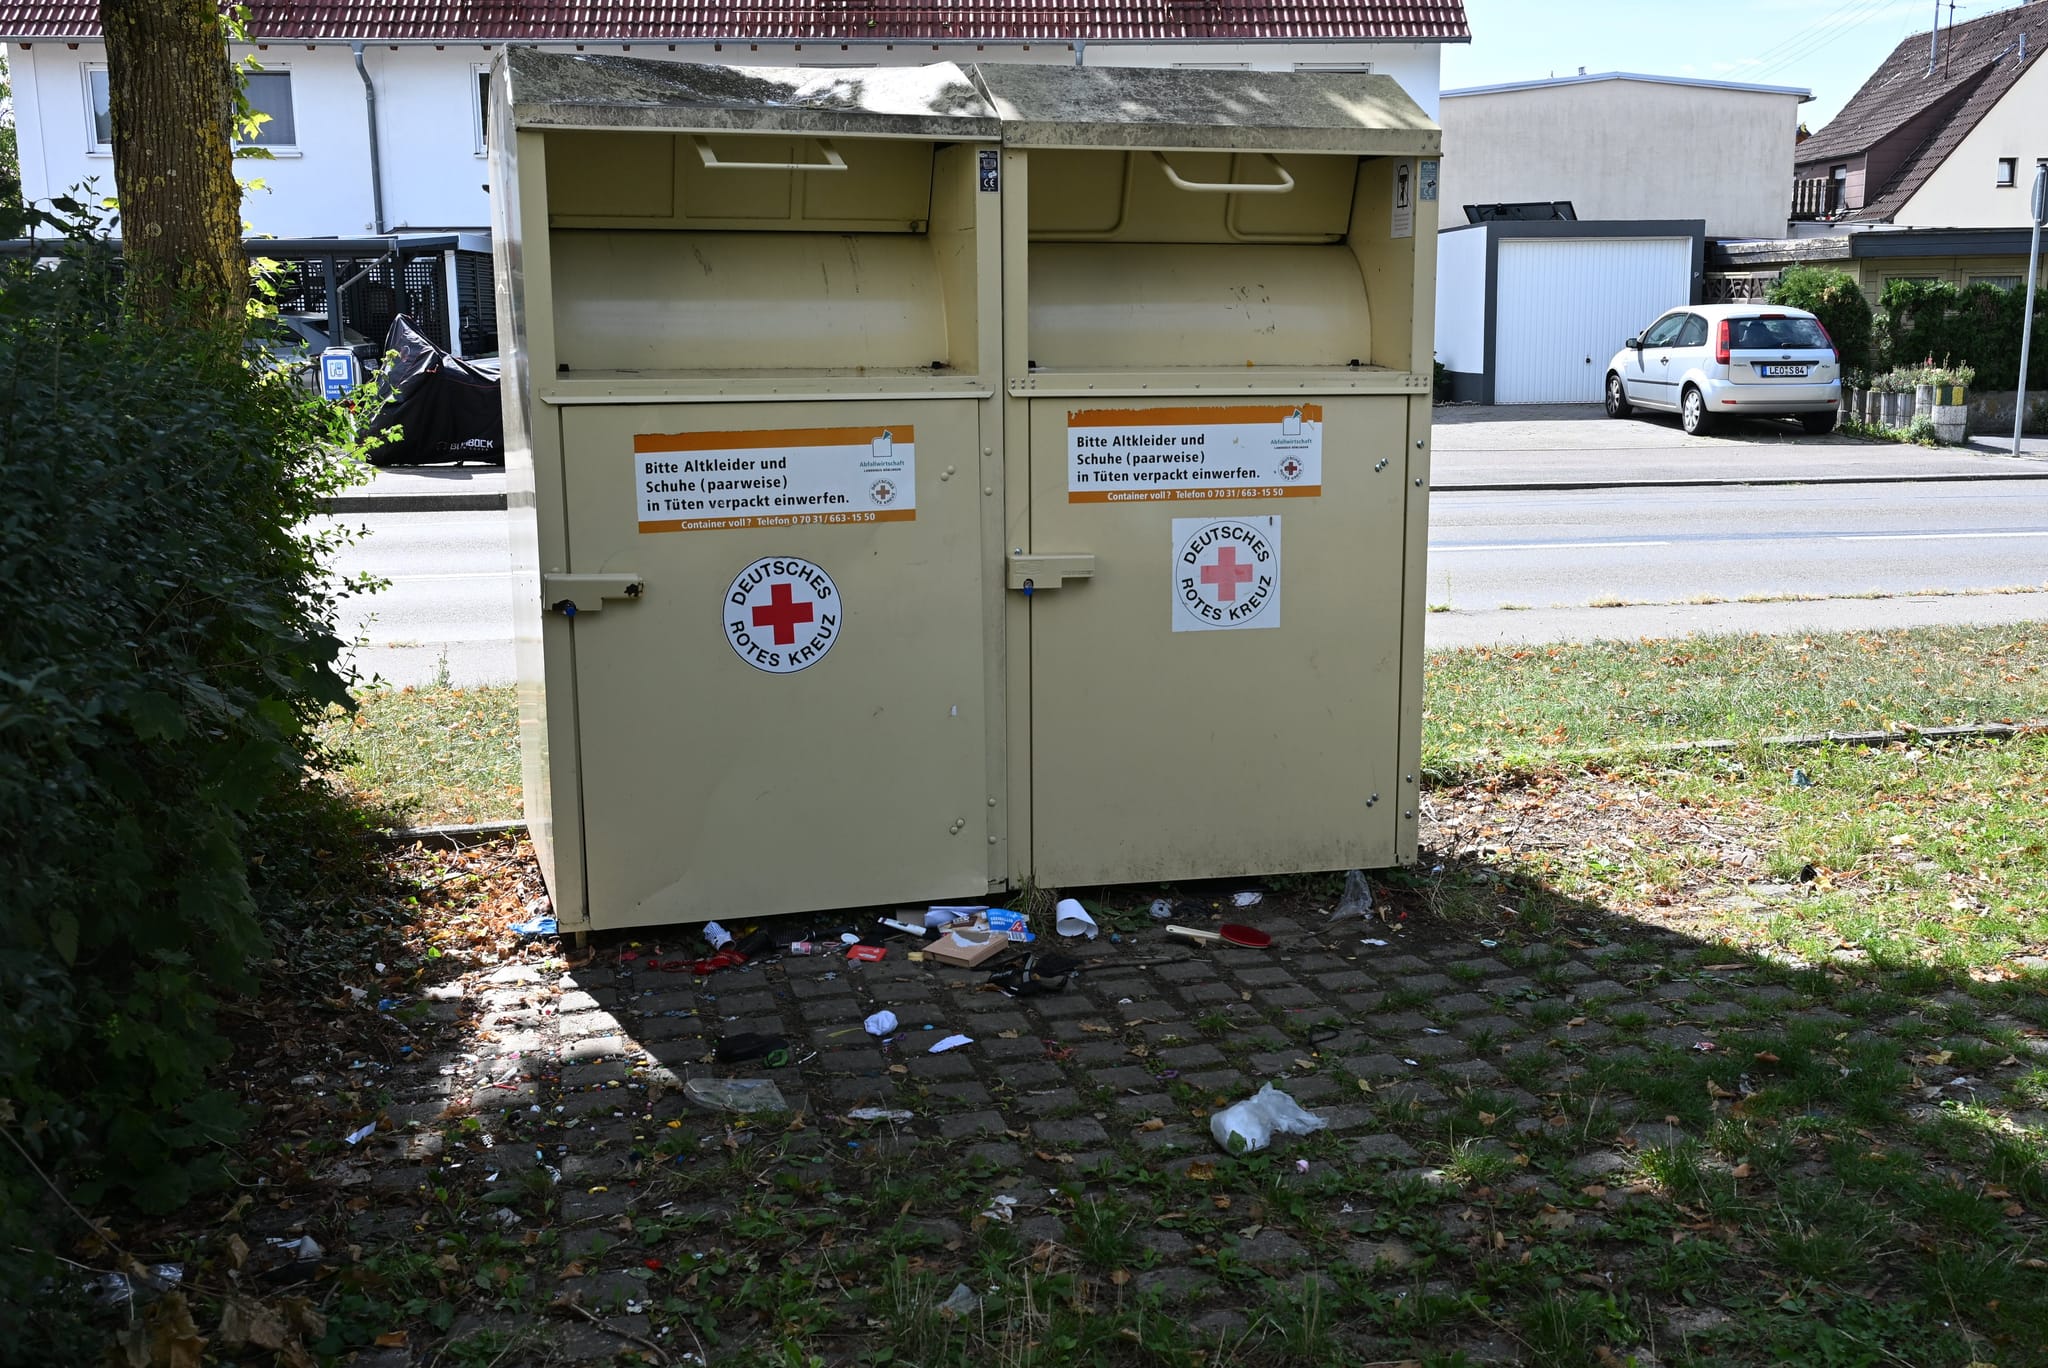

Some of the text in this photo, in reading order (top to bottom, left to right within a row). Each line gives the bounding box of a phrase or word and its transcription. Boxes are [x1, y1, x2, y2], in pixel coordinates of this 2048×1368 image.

[1769, 366, 1785, 375] LEO
[1077, 434, 1204, 448] Bitte Altkleider und
[646, 456, 786, 474] Bitte Altkleider und
[1077, 450, 1204, 466] Schuhe (paarweise)
[646, 475, 788, 494] Schuhe (paarweise)
[1077, 467, 1260, 484] in Tüten verpackt einwerfen.
[648, 492, 850, 512] in Tüten verpackt einwerfen.
[1108, 492, 1148, 500] Container
[1176, 490, 1206, 498] Telefon
[1208, 490, 1212, 498] 0
[1214, 489, 1224, 497] 70
[1273, 488, 1284, 496] 50
[682, 520, 726, 530] Container
[756, 517, 790, 526] Telefon
[792, 516, 798, 524] 0
[800, 515, 810, 524] 70
[864, 512, 876, 520] 50
[1183, 526, 1270, 565] DEUTSCHES
[731, 560, 832, 606] DEUTSCHES
[1182, 575, 1272, 620] ROTES KREUZ
[730, 614, 836, 666] ROTES KREUZ
